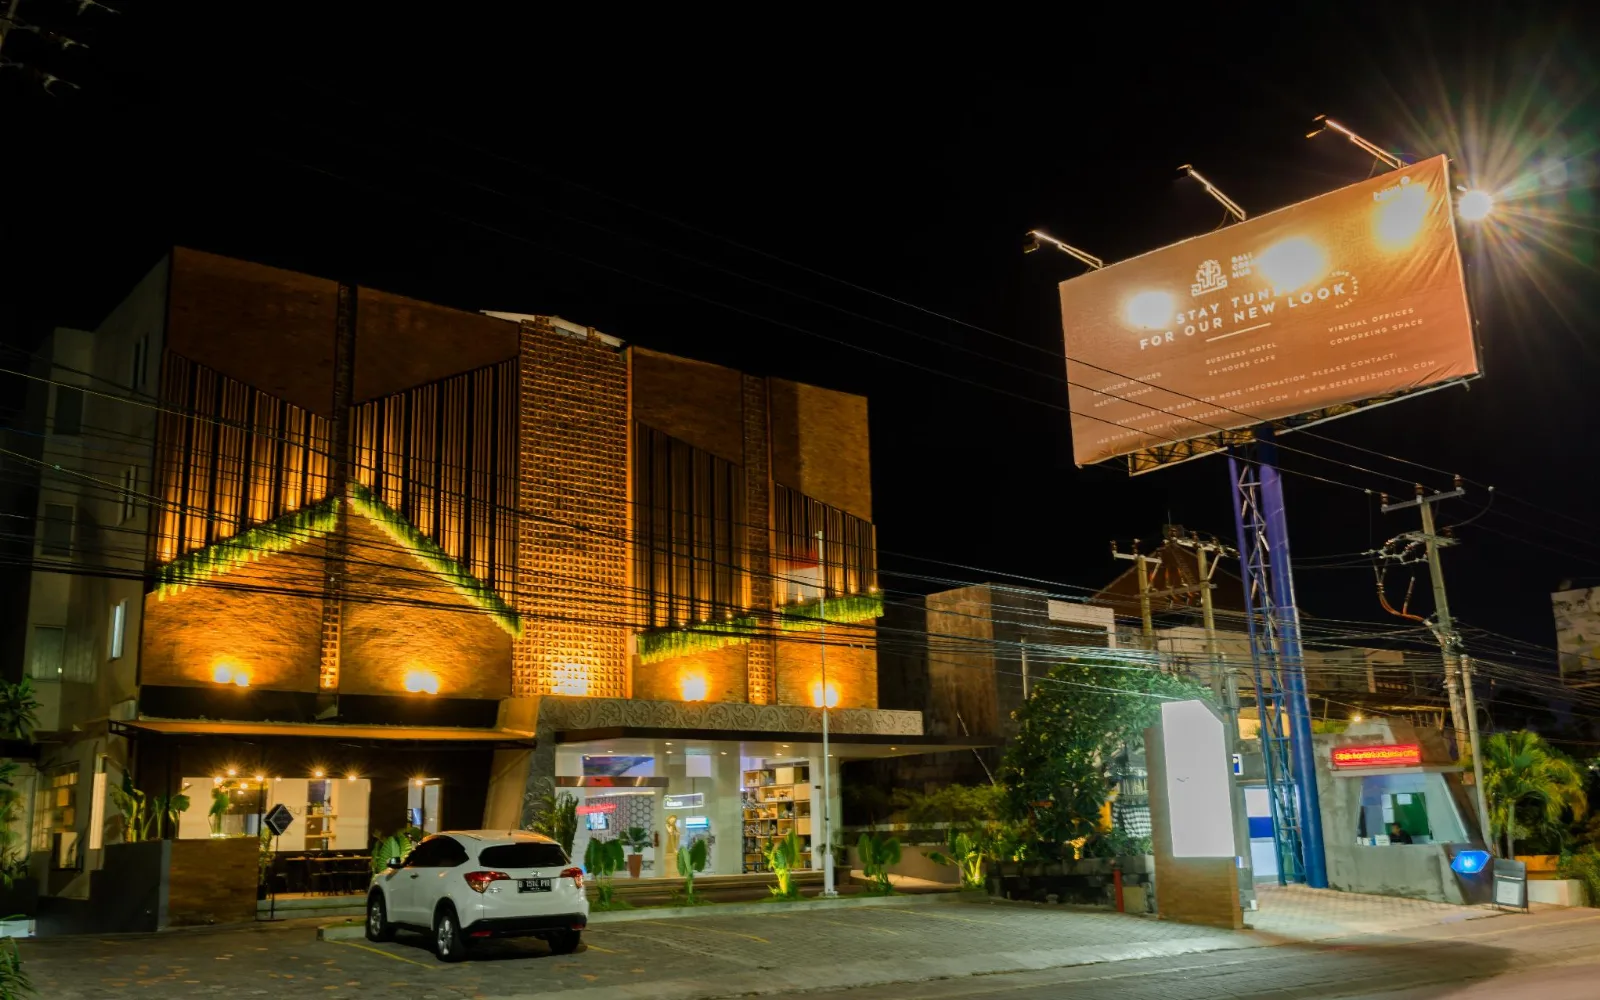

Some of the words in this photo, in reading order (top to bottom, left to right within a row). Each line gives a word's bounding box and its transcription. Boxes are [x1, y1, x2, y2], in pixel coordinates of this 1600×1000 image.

[1139, 331, 1174, 350] FOR
[1184, 317, 1223, 336] OUR
[1233, 302, 1276, 323] NEW
[1287, 283, 1346, 308] LOOK
[1175, 303, 1220, 324] STAY
[1327, 319, 1367, 332] VIRTUAL
[1371, 308, 1414, 322] OFFICES
[1329, 327, 1388, 346] COWORKING
[1391, 319, 1423, 331] SPACE
[1205, 350, 1246, 364] BUSINESS
[1249, 342, 1278, 353] HOTEL
[1208, 361, 1250, 376] 24-HOURS
[1253, 355, 1275, 364] CAFE
[1219, 389, 1241, 399] MORE
[1312, 365, 1347, 377] PLEASE
